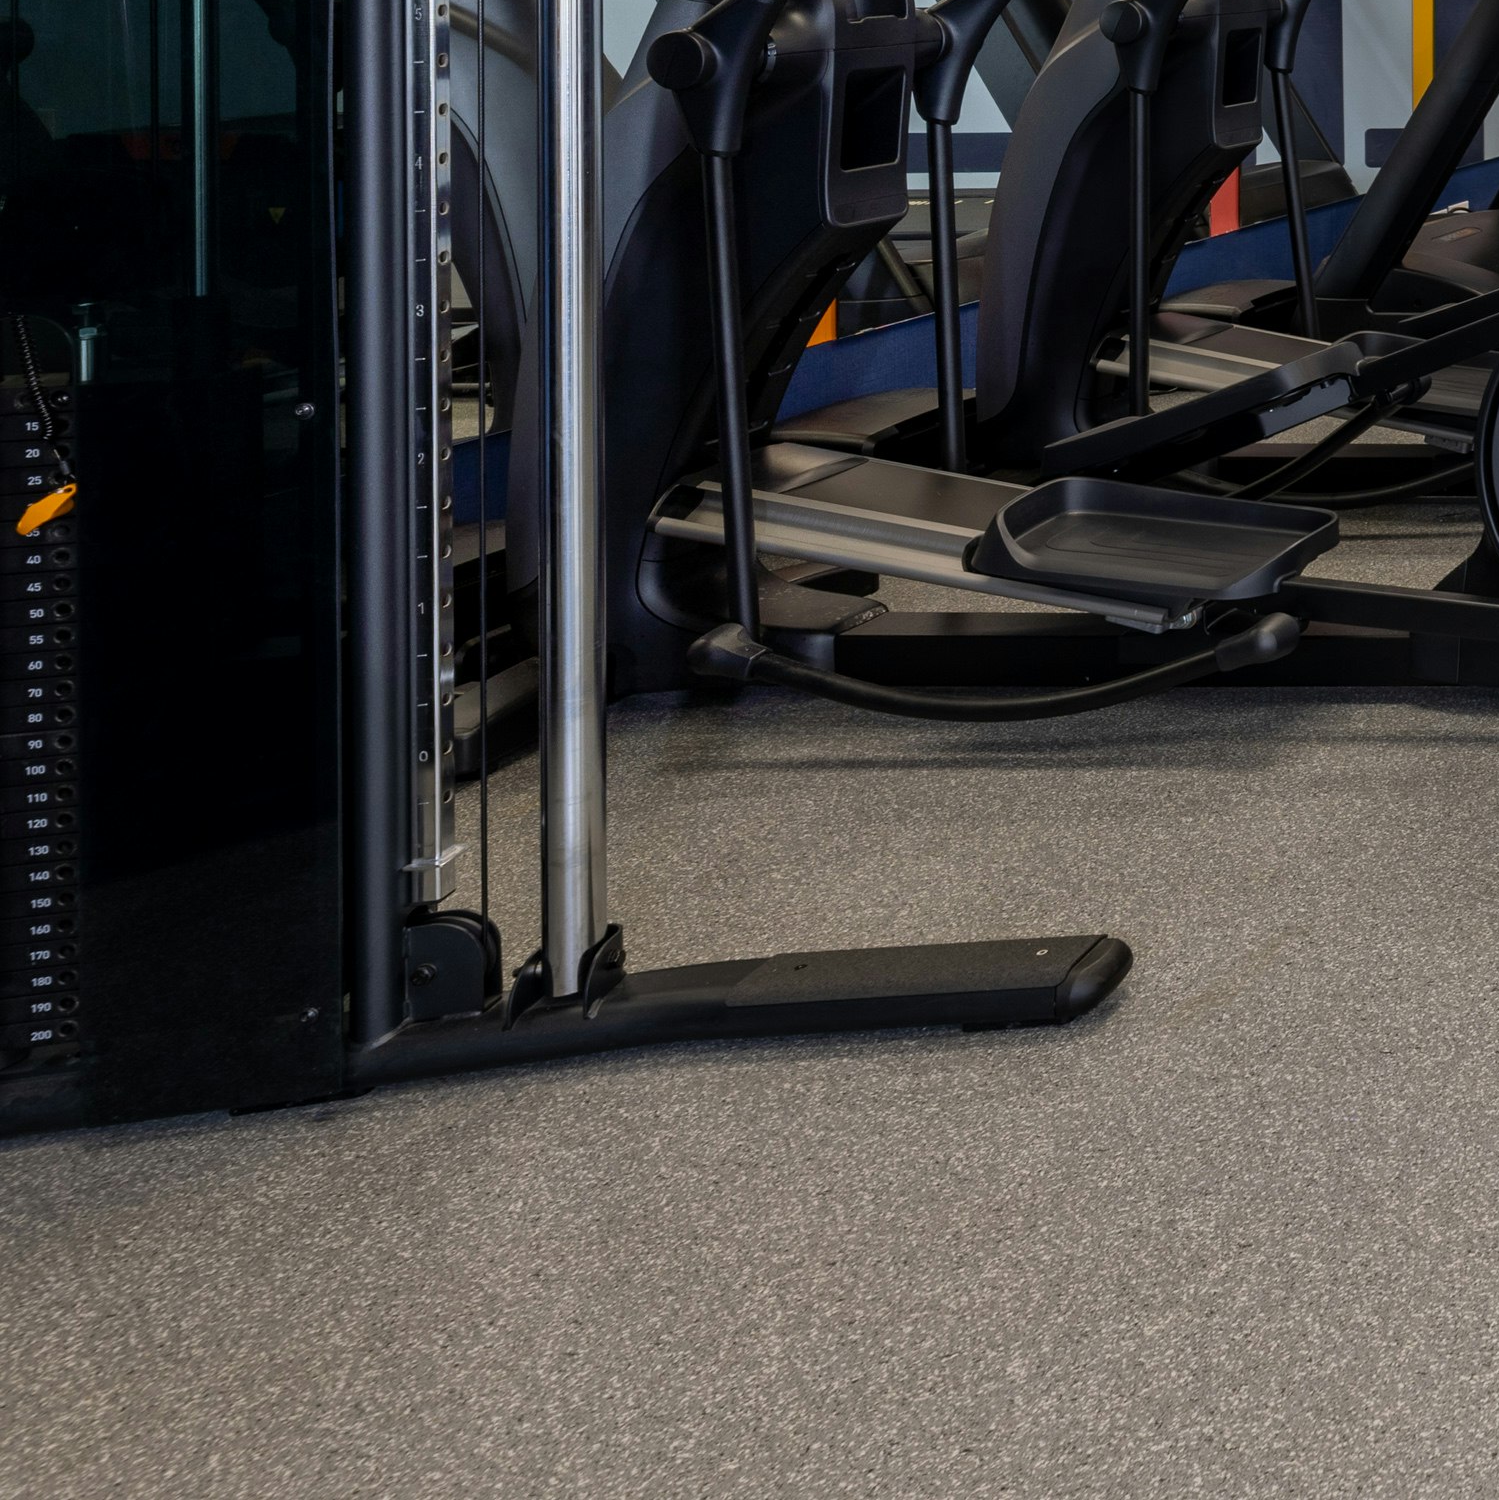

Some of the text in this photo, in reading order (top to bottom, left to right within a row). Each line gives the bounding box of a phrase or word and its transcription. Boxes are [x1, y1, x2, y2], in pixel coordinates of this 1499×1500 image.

[416, 8, 422, 20] 5
[415, 157, 422, 169] 4
[416, 305, 423, 316] 3
[26, 422, 38, 430] 15
[26, 449, 39, 458] 20
[418, 453, 424, 464] 2
[28, 476, 41, 485] 25
[27, 555, 41, 564] 40
[27, 583, 41, 591] 45
[418, 603, 424, 614] 1
[30, 609, 43, 618] 50
[30, 635, 43, 644] 55
[28, 661, 42, 670] 60
[28, 689, 42, 697] 70
[28, 714, 42, 722] 80
[28, 740, 42, 749] 90
[419, 751, 428, 761] 0
[26, 765, 45, 775] 100
[27, 793, 47, 802] 110
[28, 819, 47, 828] 120
[29, 846, 49, 855] 130
[30, 871, 49, 881] 140
[31, 898, 51, 908] 150
[31, 925, 50, 935] 160
[30, 951, 50, 960] 170
[32, 976, 51, 986] 180
[32, 1003, 51, 1012] 190
[31, 1030, 51, 1041] 200
